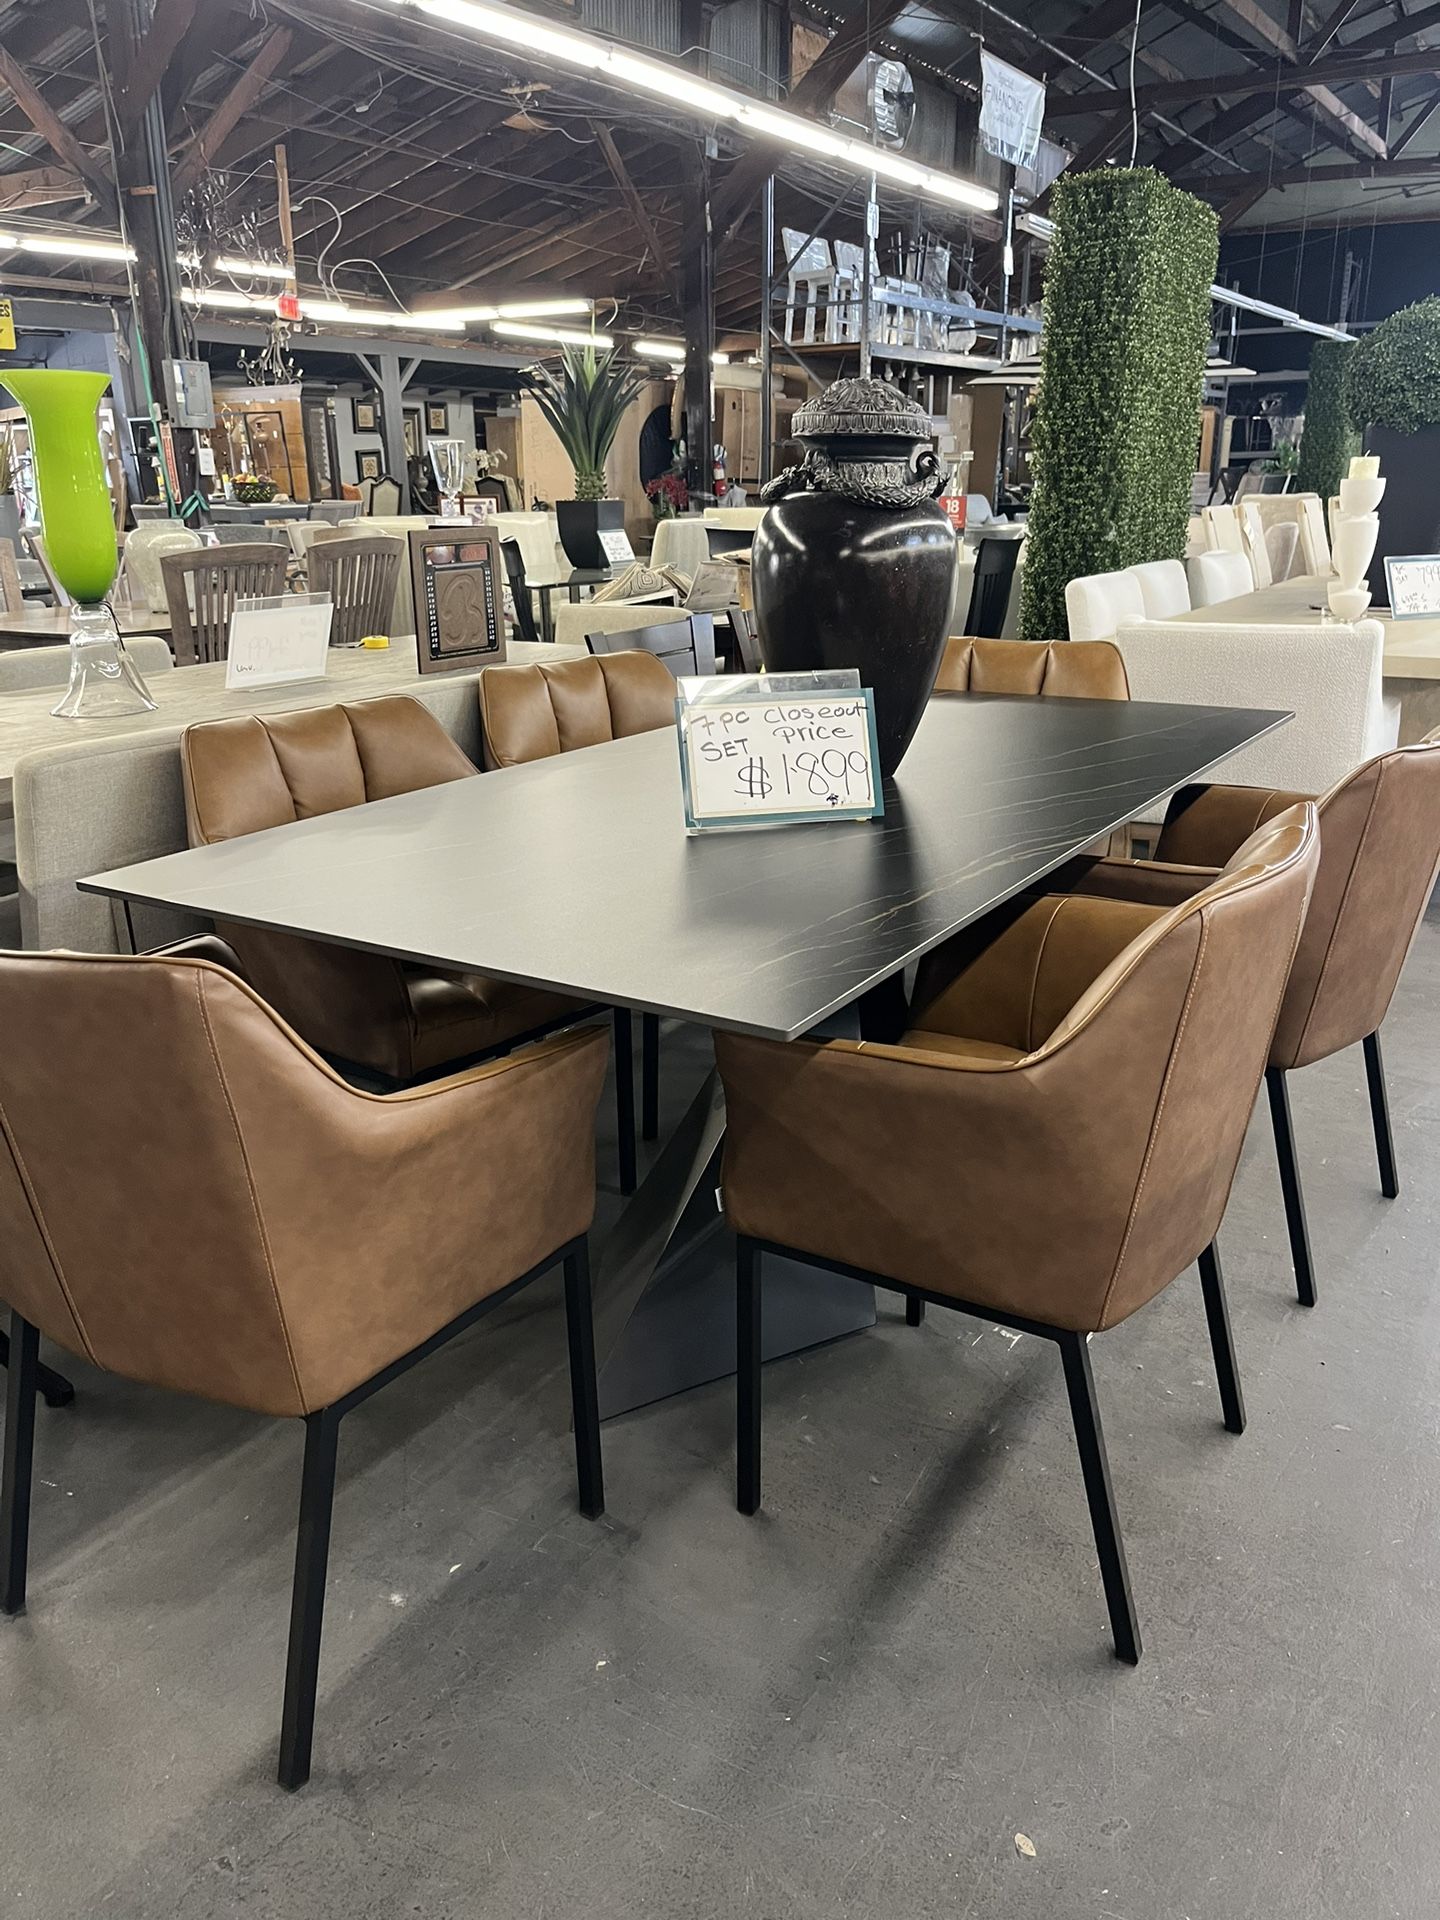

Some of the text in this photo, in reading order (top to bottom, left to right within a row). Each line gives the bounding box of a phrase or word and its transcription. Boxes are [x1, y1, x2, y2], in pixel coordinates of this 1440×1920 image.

[945, 499, 960, 514] 18
[764, 702, 869, 724] Closeout
[700, 738, 749, 762] SET
